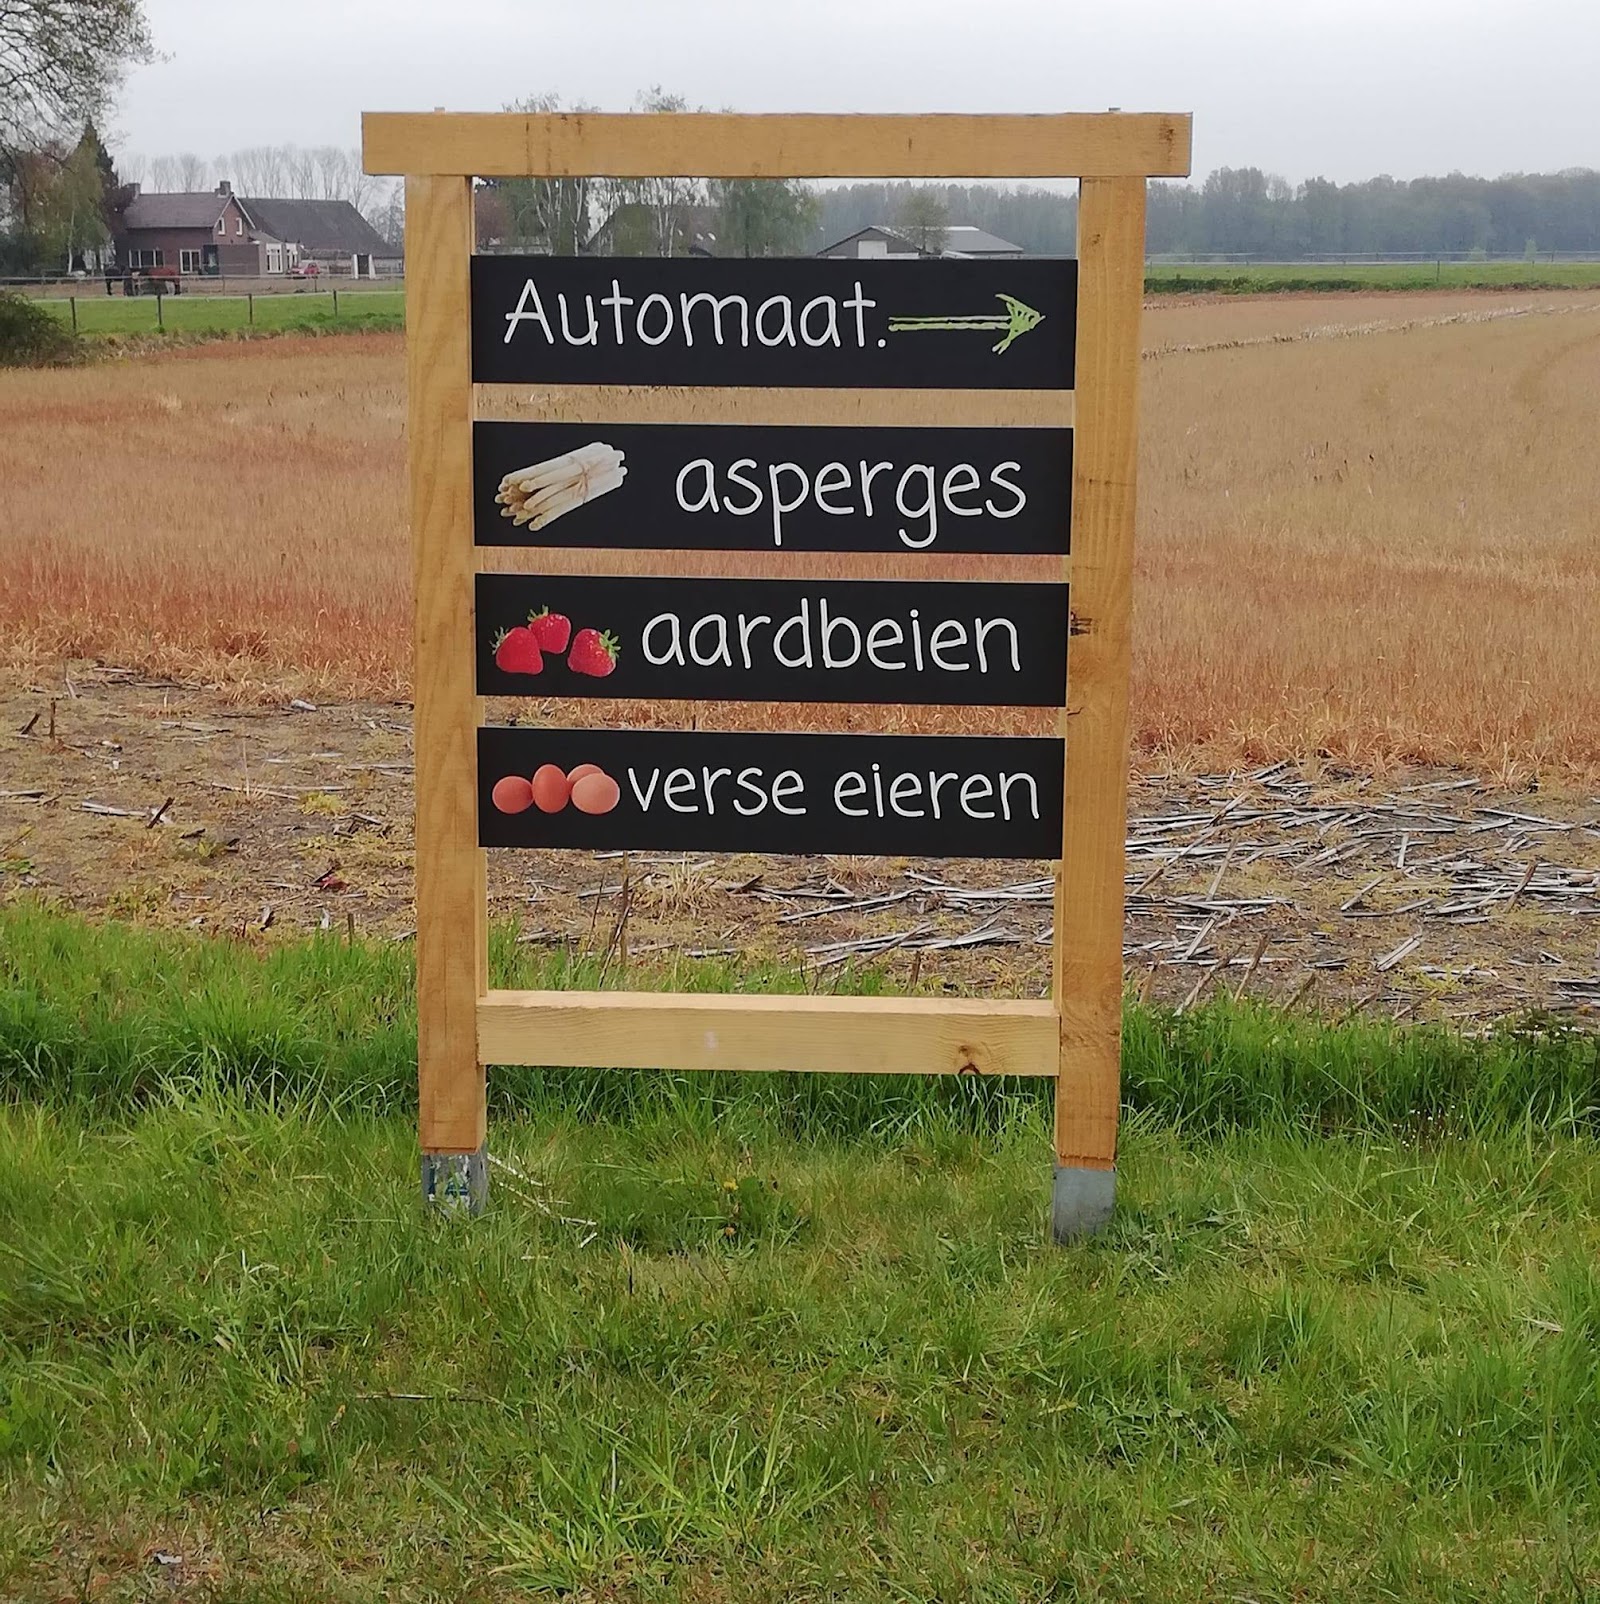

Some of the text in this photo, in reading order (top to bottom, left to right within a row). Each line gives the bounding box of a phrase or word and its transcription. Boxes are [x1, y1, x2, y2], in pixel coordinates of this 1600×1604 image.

[675, 457, 1027, 549] asperges
[641, 597, 1021, 673] aardbeien
[627, 763, 1040, 821] verse eieren
